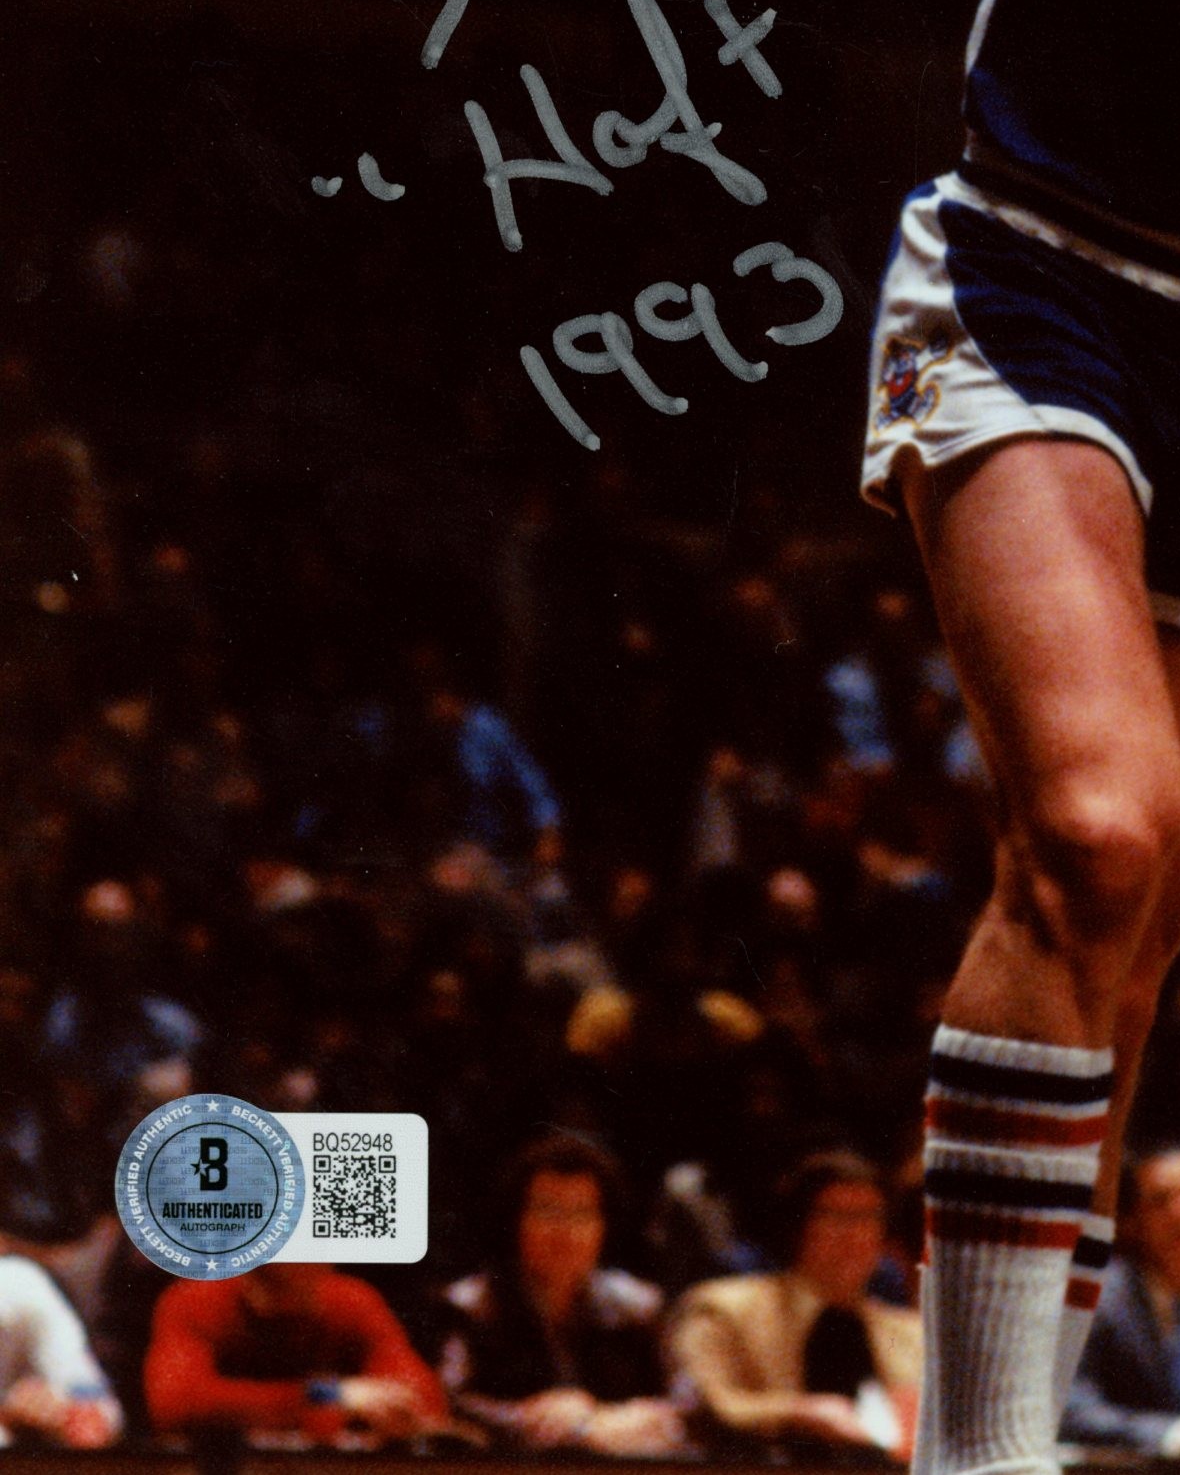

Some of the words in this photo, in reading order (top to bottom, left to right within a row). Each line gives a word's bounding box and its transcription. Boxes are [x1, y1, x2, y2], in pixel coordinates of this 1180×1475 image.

[519, 241, 845, 451] 1993
[134, 1104, 193, 1161] AUTHENTIC
[231, 1105, 283, 1147] BECKETT
[313, 1132, 393, 1152] BQ52948
[199, 1137, 228, 1191] B
[127, 1162, 145, 1225] VERIFIED
[162, 1202, 263, 1219] AUTHENTICATED
[140, 1227, 192, 1268] BECKETT
[179, 1222, 246, 1232] AUTOGRAPH
[231, 1211, 289, 1268] AUTHENTIC
